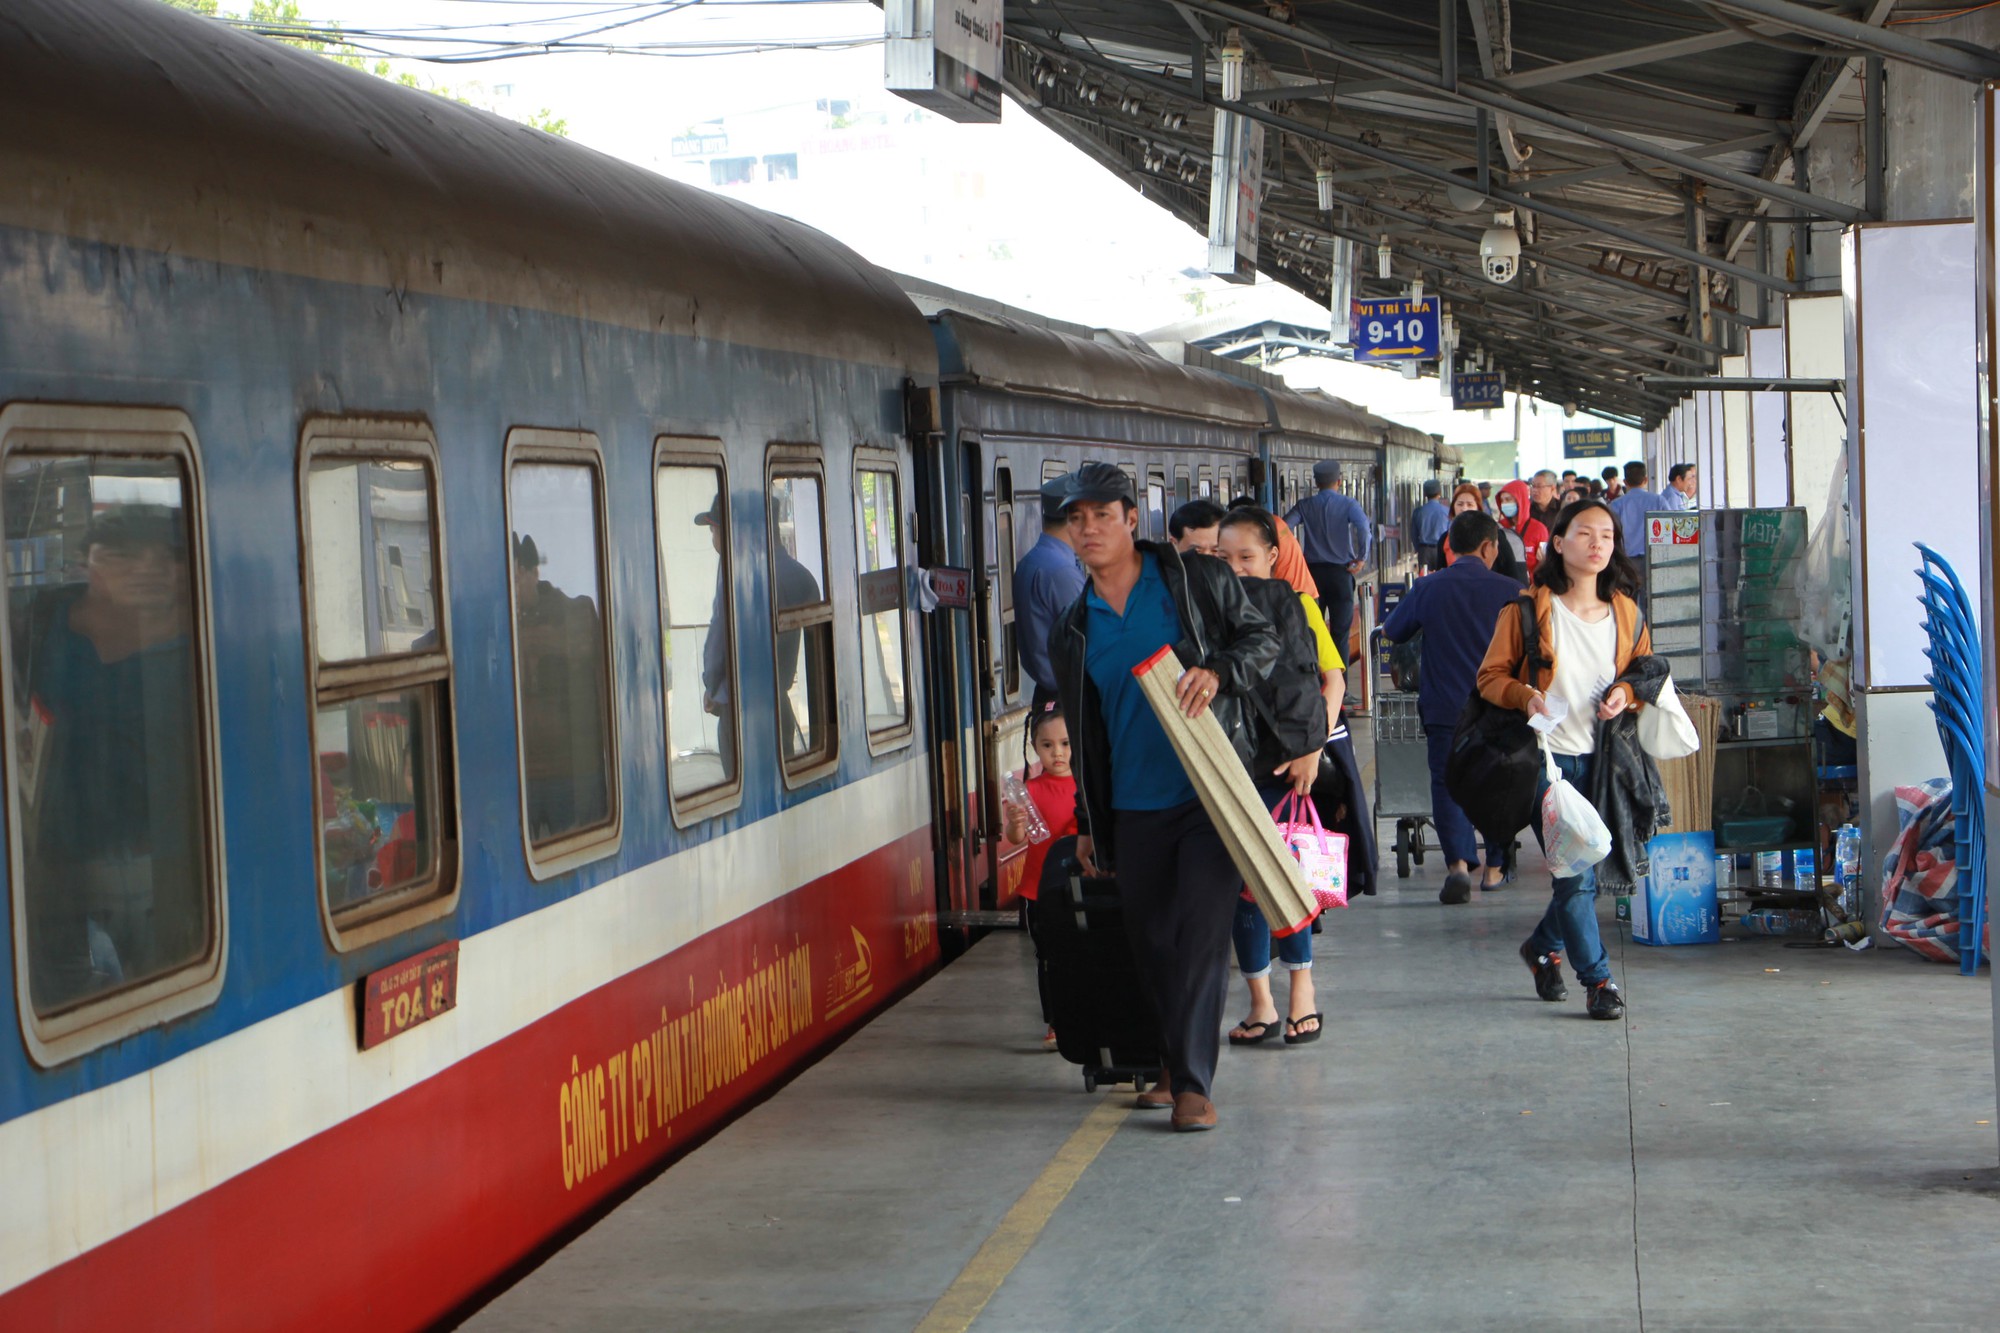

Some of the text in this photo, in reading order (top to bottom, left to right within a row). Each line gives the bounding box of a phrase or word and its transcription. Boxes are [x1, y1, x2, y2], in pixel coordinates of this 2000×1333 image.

[1360, 305, 1373, 317] VỊ
[1379, 303, 1399, 315] TRÍ
[1368, 319, 1424, 344] 9-10
[1458, 384, 1500, 400] 11-12
[938, 580, 965, 597] TOA 8
[381, 976, 443, 1035] TOA 8
[560, 932, 813, 1191] CÔNG TY CP VẬN TẢI ĐƯỜNG SẮT SÀI GÒN
